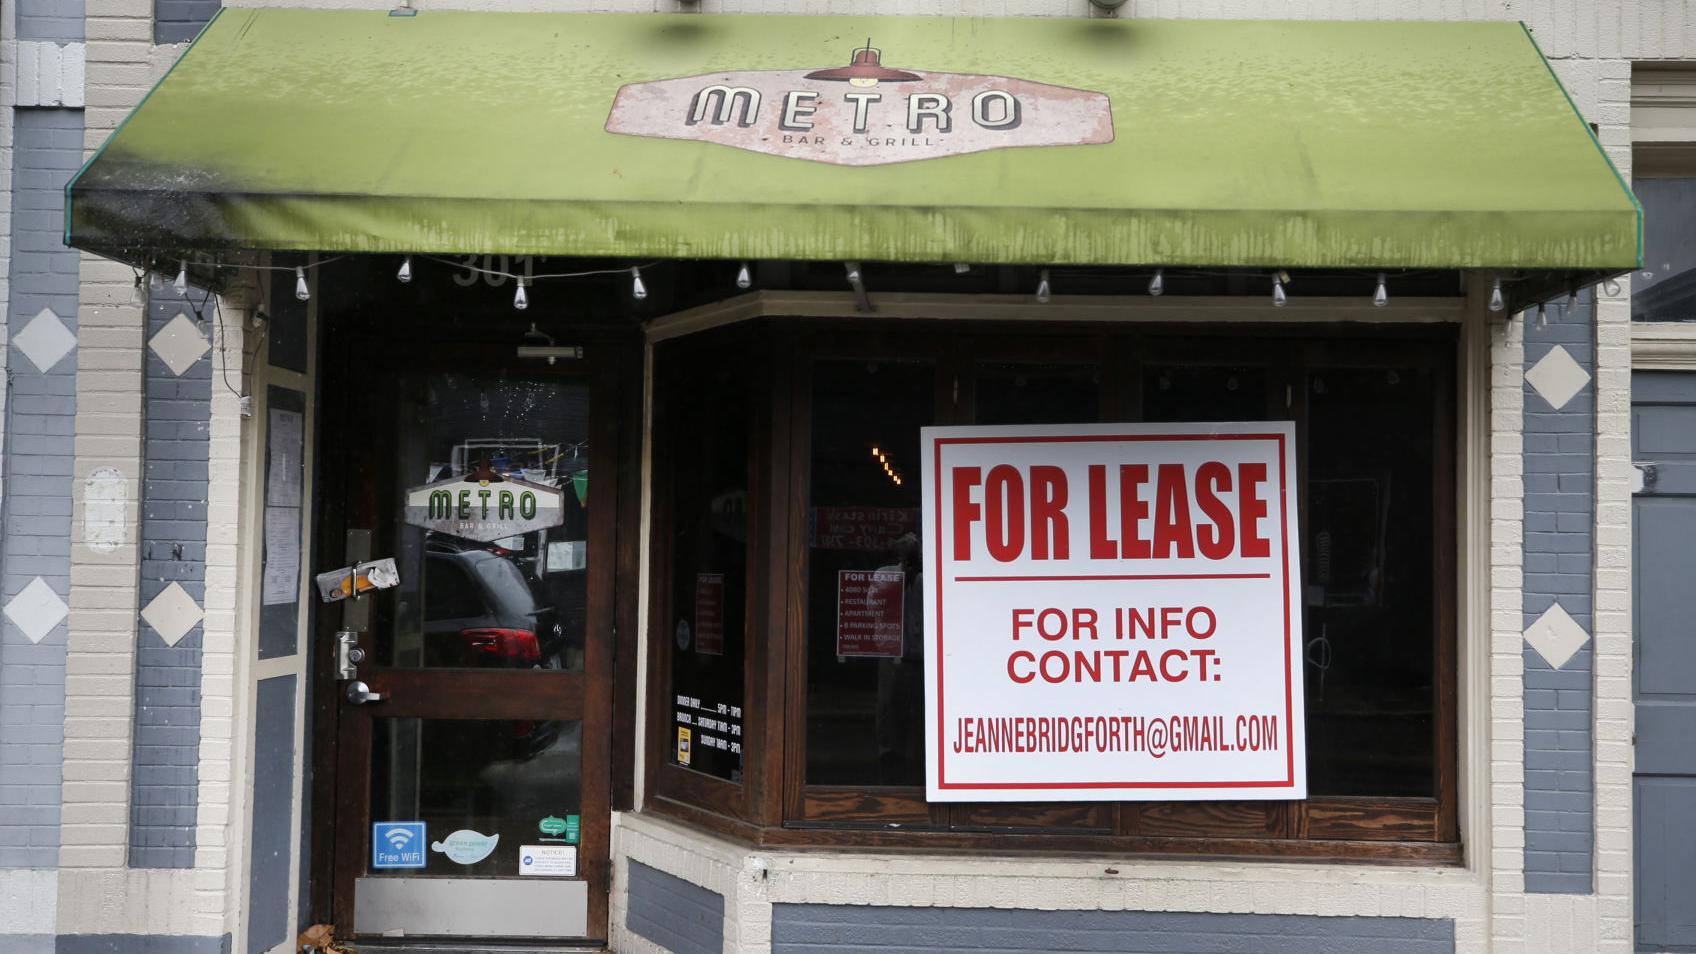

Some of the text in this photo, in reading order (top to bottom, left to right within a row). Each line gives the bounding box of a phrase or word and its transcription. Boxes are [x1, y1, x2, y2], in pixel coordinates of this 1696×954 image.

[684, 84, 1022, 133] METRO
[782, 135, 935, 147] BAR & GRILL
[428, 489, 537, 521] METRO
[952, 461, 1271, 562] FOR LEASE
[844, 573, 900, 583] FOR LEASE
[1011, 606, 1217, 641] FOR INFO
[1006, 648, 1222, 684] CONTACT:
[953, 714, 1278, 758] JEANNEBRIDGFORTH@GMAIL.COM
[379, 852, 420, 862] Free WiFi
